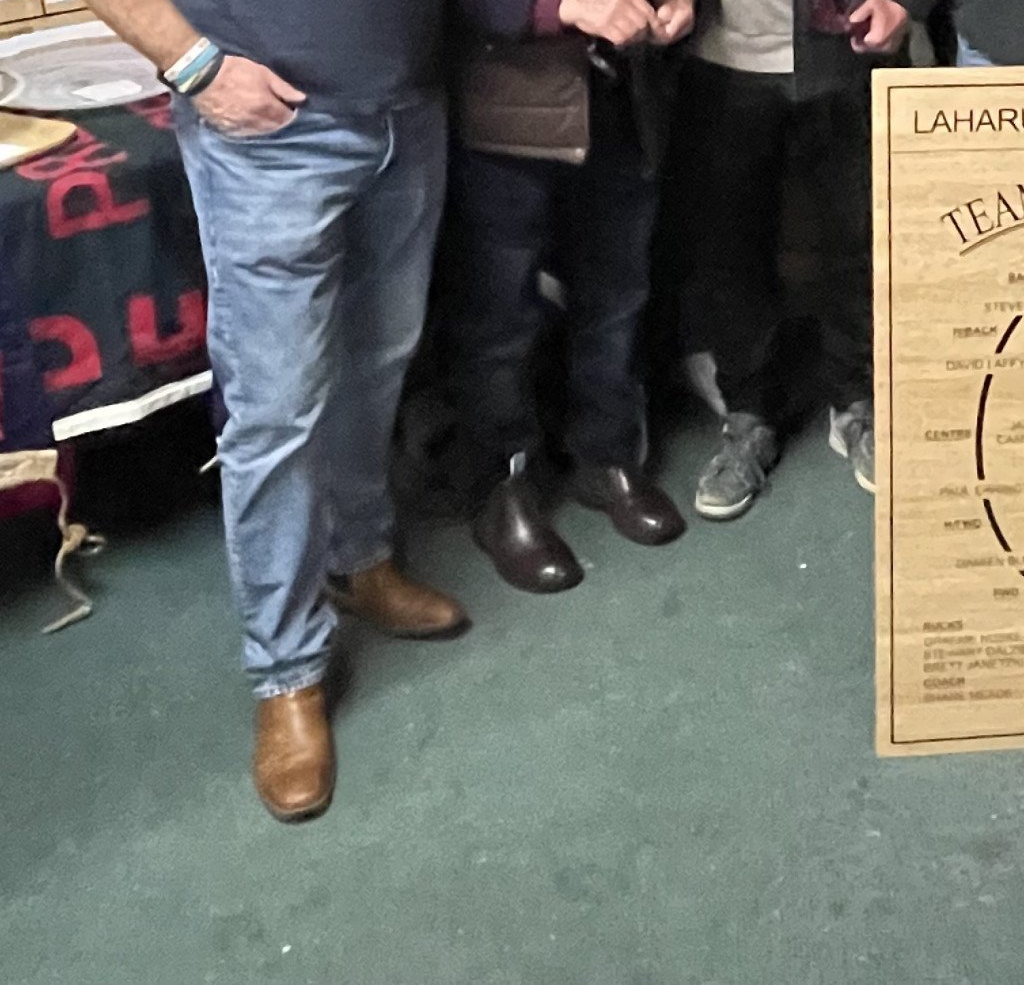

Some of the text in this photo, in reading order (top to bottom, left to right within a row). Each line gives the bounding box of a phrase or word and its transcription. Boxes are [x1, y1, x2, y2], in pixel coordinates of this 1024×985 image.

[984, 301, 1024, 312] STEVE
[945, 359, 983, 371] DAVID
[924, 429, 972, 441] CENTRE
